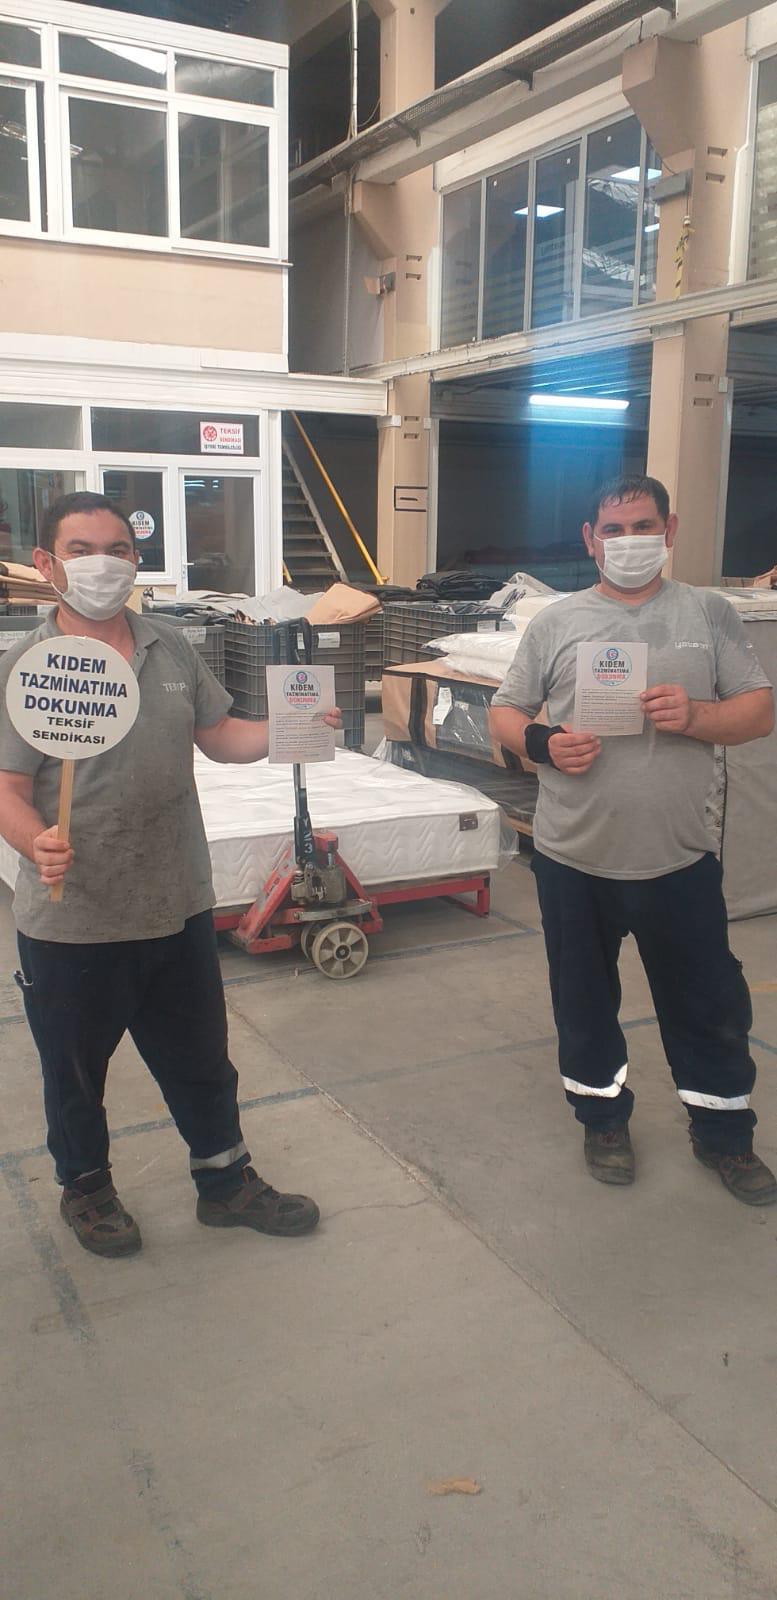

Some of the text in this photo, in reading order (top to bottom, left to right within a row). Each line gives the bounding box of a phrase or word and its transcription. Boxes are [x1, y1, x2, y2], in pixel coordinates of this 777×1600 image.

[47, 653, 107, 674] KIDEM
[599, 660, 625, 668] KIDEM
[20, 671, 128, 698] TAZMİNATIMA
[290, 683, 315, 692] KIDEM
[24, 694, 118, 718] DOKUNMA
[46, 716, 96, 729] TEKSİF
[32, 729, 106, 745] SENDİKASI
